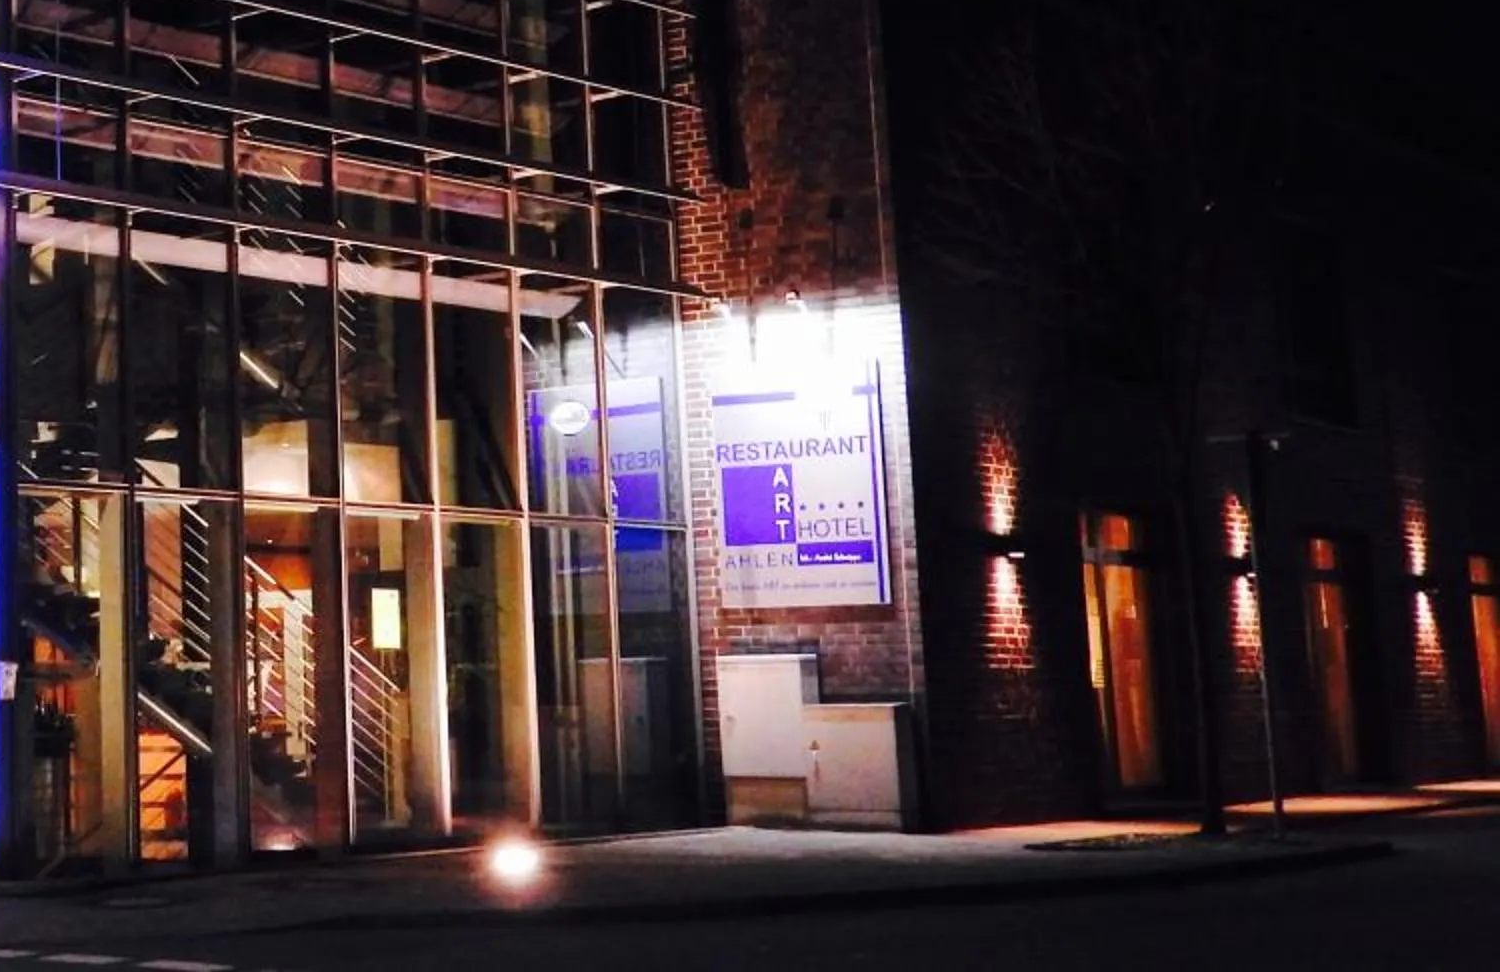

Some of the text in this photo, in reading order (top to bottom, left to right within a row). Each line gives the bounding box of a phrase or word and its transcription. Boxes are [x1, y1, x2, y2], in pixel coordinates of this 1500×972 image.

[716, 435, 869, 463] RESTAURANT
[772, 466, 793, 541] ART
[798, 517, 871, 538] HOTEL
[724, 551, 793, 569] AHLEN
